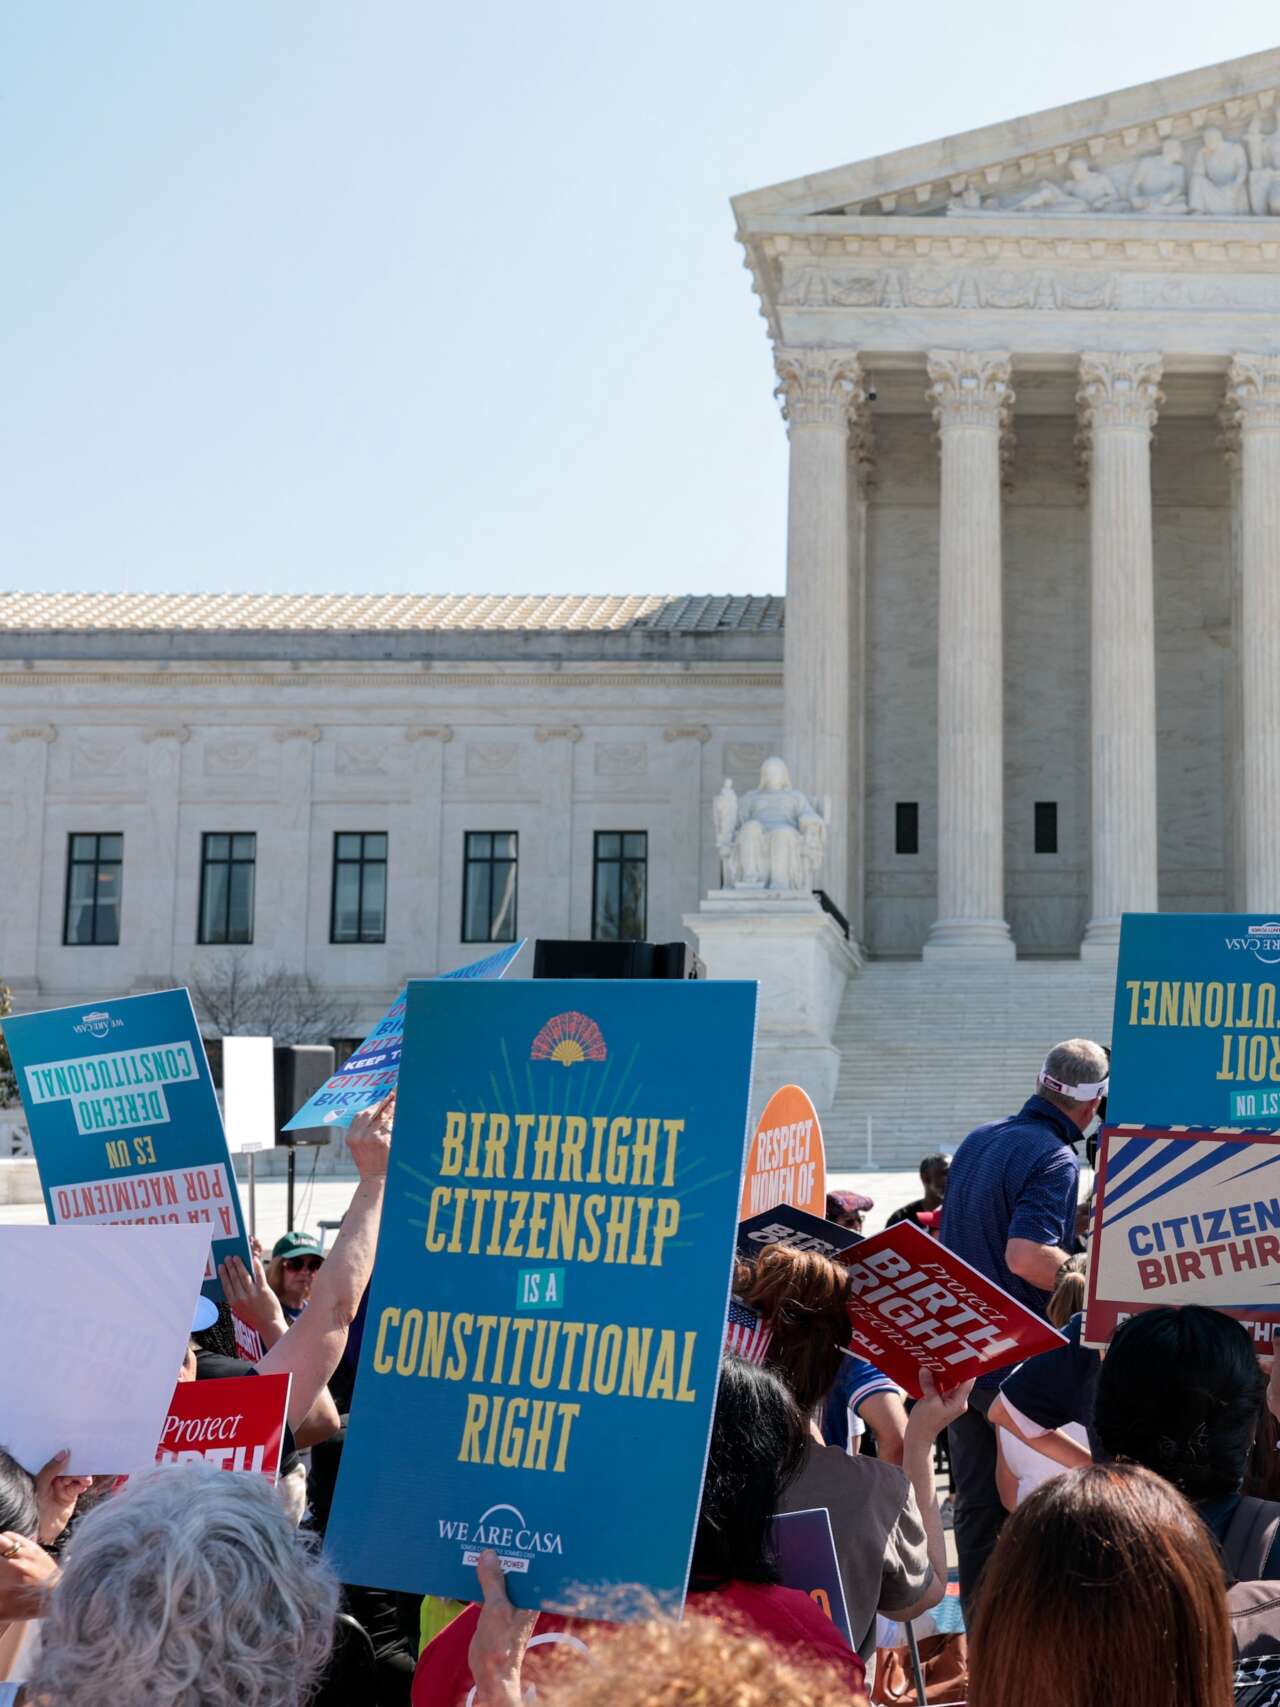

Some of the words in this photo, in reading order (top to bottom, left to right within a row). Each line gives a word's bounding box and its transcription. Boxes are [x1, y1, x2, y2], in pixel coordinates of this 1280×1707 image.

[1225, 938, 1260, 951] CASA
[31, 1047, 193, 1099] CONSTITUCIONAL
[328, 1070, 399, 1089] CITIZE
[344, 1055, 386, 1071] KEEP
[79, 1090, 164, 1130] DERECHO
[1236, 1093, 1256, 1117] UN
[105, 1139, 131, 1169] UN
[137, 1136, 157, 1165] ES
[439, 1111, 685, 1187] BIRTHRIGHT
[756, 1119, 814, 1173] RESPECT
[57, 1175, 177, 1220] NACIMIENTO
[183, 1169, 224, 1201] POR
[750, 1167, 795, 1214] WOMEN
[797, 1162, 816, 1206] OF
[425, 1186, 680, 1266] CITIZENSHIP
[523, 1273, 540, 1303] IS
[545, 1272, 557, 1302] A
[863, 1247, 1019, 1356] BIRTH
[918, 1263, 1009, 1322] Protect
[850, 1263, 989, 1365] RIGHT
[373, 1307, 697, 1402] CONSTITUTIONAL
[851, 1329, 886, 1356] CLU
[160, 1414, 243, 1444] Protect
[457, 1393, 581, 1473] RIGHT
[438, 1519, 470, 1541] WE
[472, 1524, 513, 1547] ARE
[515, 1529, 563, 1555] CASA
